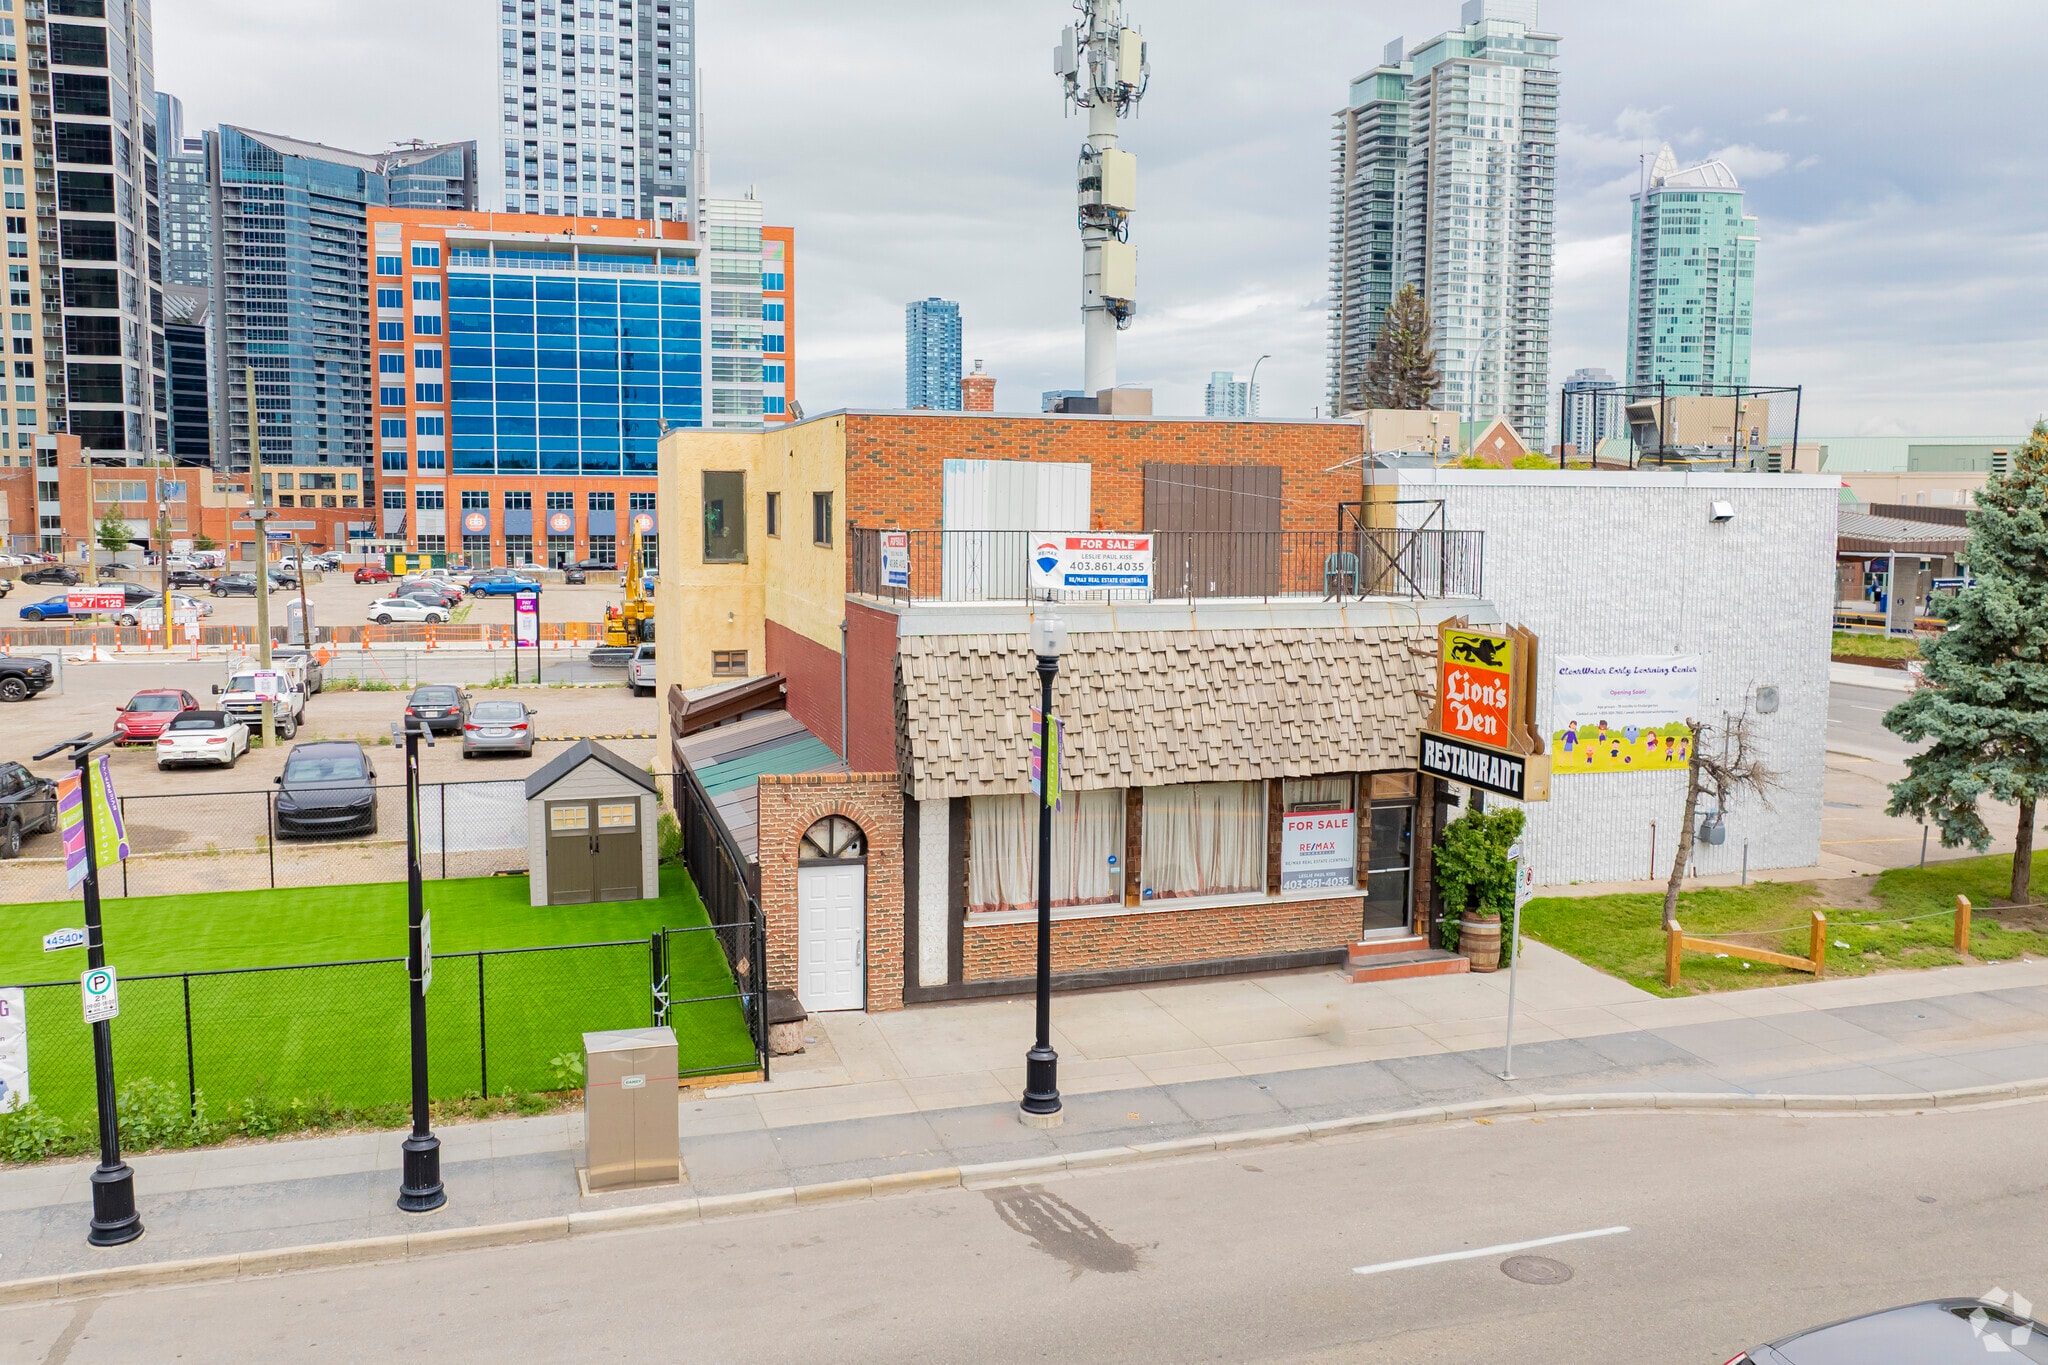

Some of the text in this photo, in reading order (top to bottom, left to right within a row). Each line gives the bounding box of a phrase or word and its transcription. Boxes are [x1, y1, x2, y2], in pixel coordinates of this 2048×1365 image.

[1080, 540, 1135, 549] FOR SALE
[1070, 562, 1144, 571] 403.861.4035
[100, 600, 122, 608] $125
[1608, 667, 1632, 676] Early
[1634, 666, 1669, 676] Learning
[1672, 666, 1697, 674] Center
[1446, 670, 1507, 709] Lion's
[1450, 700, 1498, 736] Den
[1424, 739, 1522, 792] RESTAURANT
[1288, 819, 1348, 832] FOR SALE
[1300, 842, 1335, 851] RE/MAX
[1284, 876, 1349, 890] 403-861-4035
[52, 932, 78, 945] 4540
[94, 976, 106, 990] P
